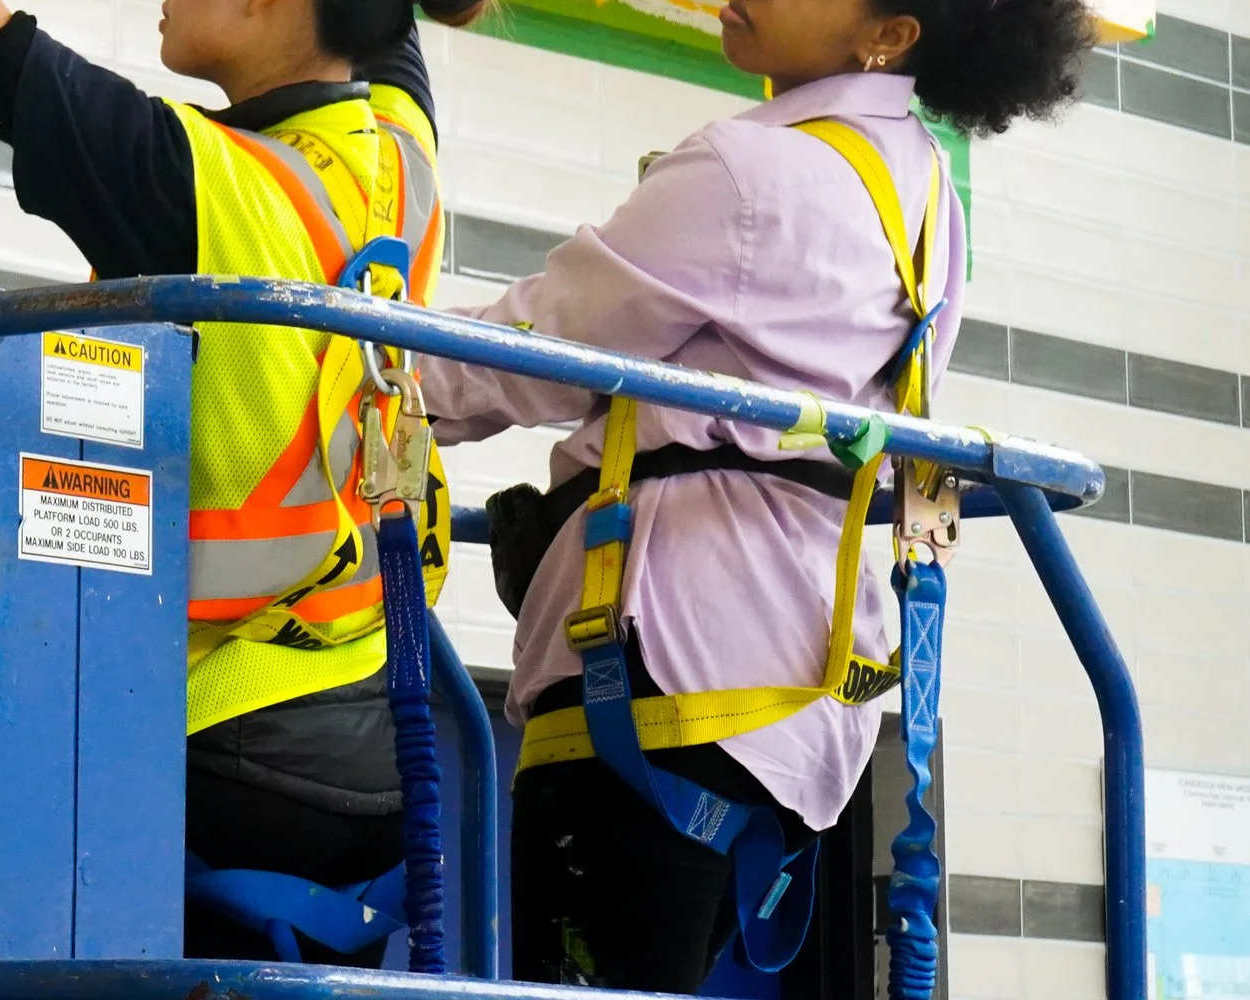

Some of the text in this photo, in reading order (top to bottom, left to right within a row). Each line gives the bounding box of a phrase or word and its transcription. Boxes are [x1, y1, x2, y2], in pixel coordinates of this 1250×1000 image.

[68, 341, 131, 367] CAUTION
[59, 471, 130, 499] WARNING
[40, 495, 133, 516] MAXIMUM DISTRIBUTED
[34, 509, 139, 533] PLATFORM LOAD 500 LBS.
[51, 526, 122, 545] OR 2 OCCUPANTS
[25, 537, 147, 562] MAXIMUM SIDE LOAD 100 LBS.
[420, 533, 444, 568] A
